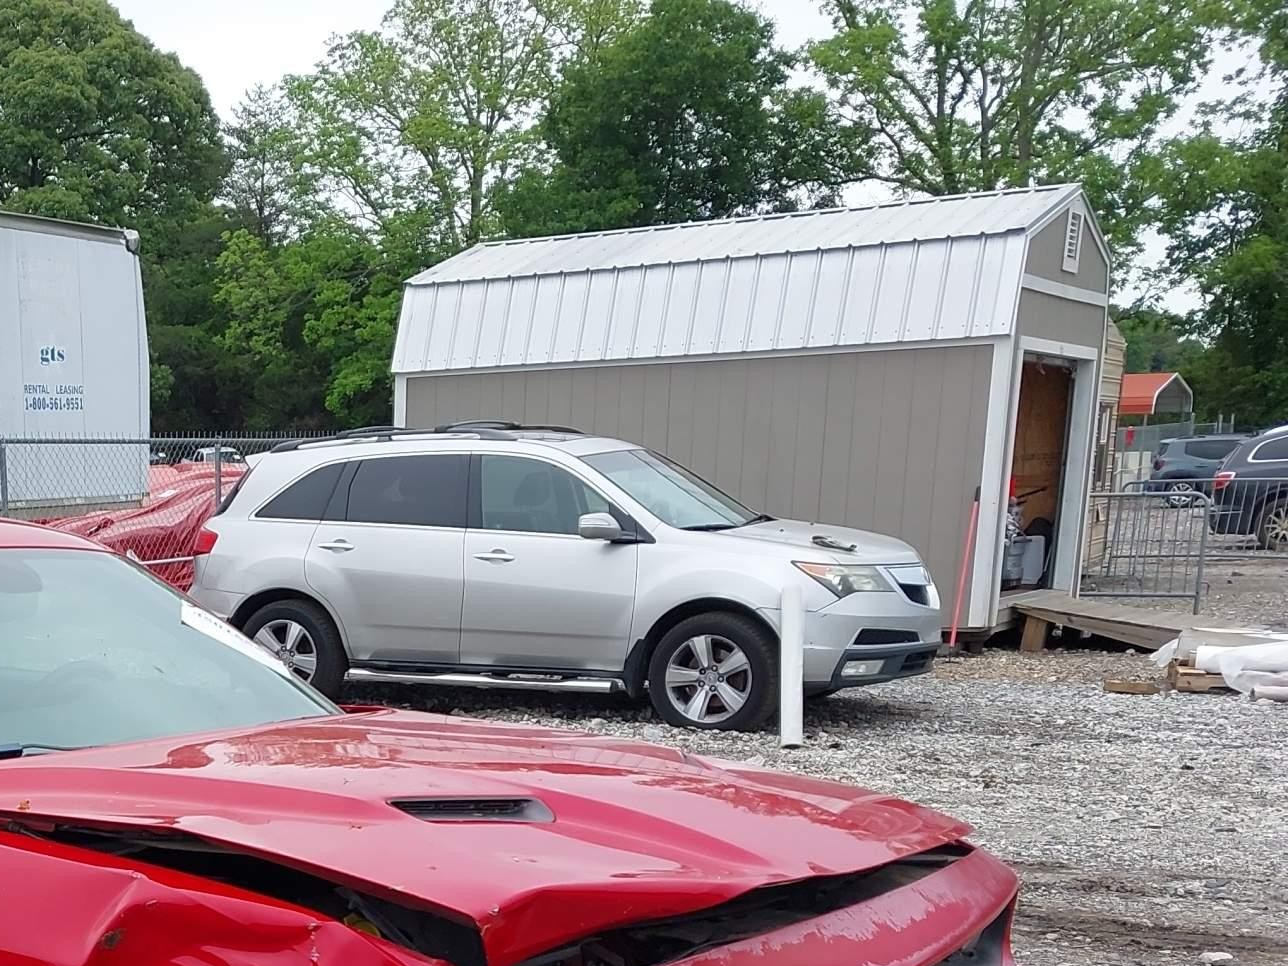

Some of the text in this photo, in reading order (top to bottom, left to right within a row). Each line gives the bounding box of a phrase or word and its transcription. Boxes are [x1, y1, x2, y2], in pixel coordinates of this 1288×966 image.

[40, 345, 65, 366] gts
[24, 384, 84, 395] RENTAL LEASING
